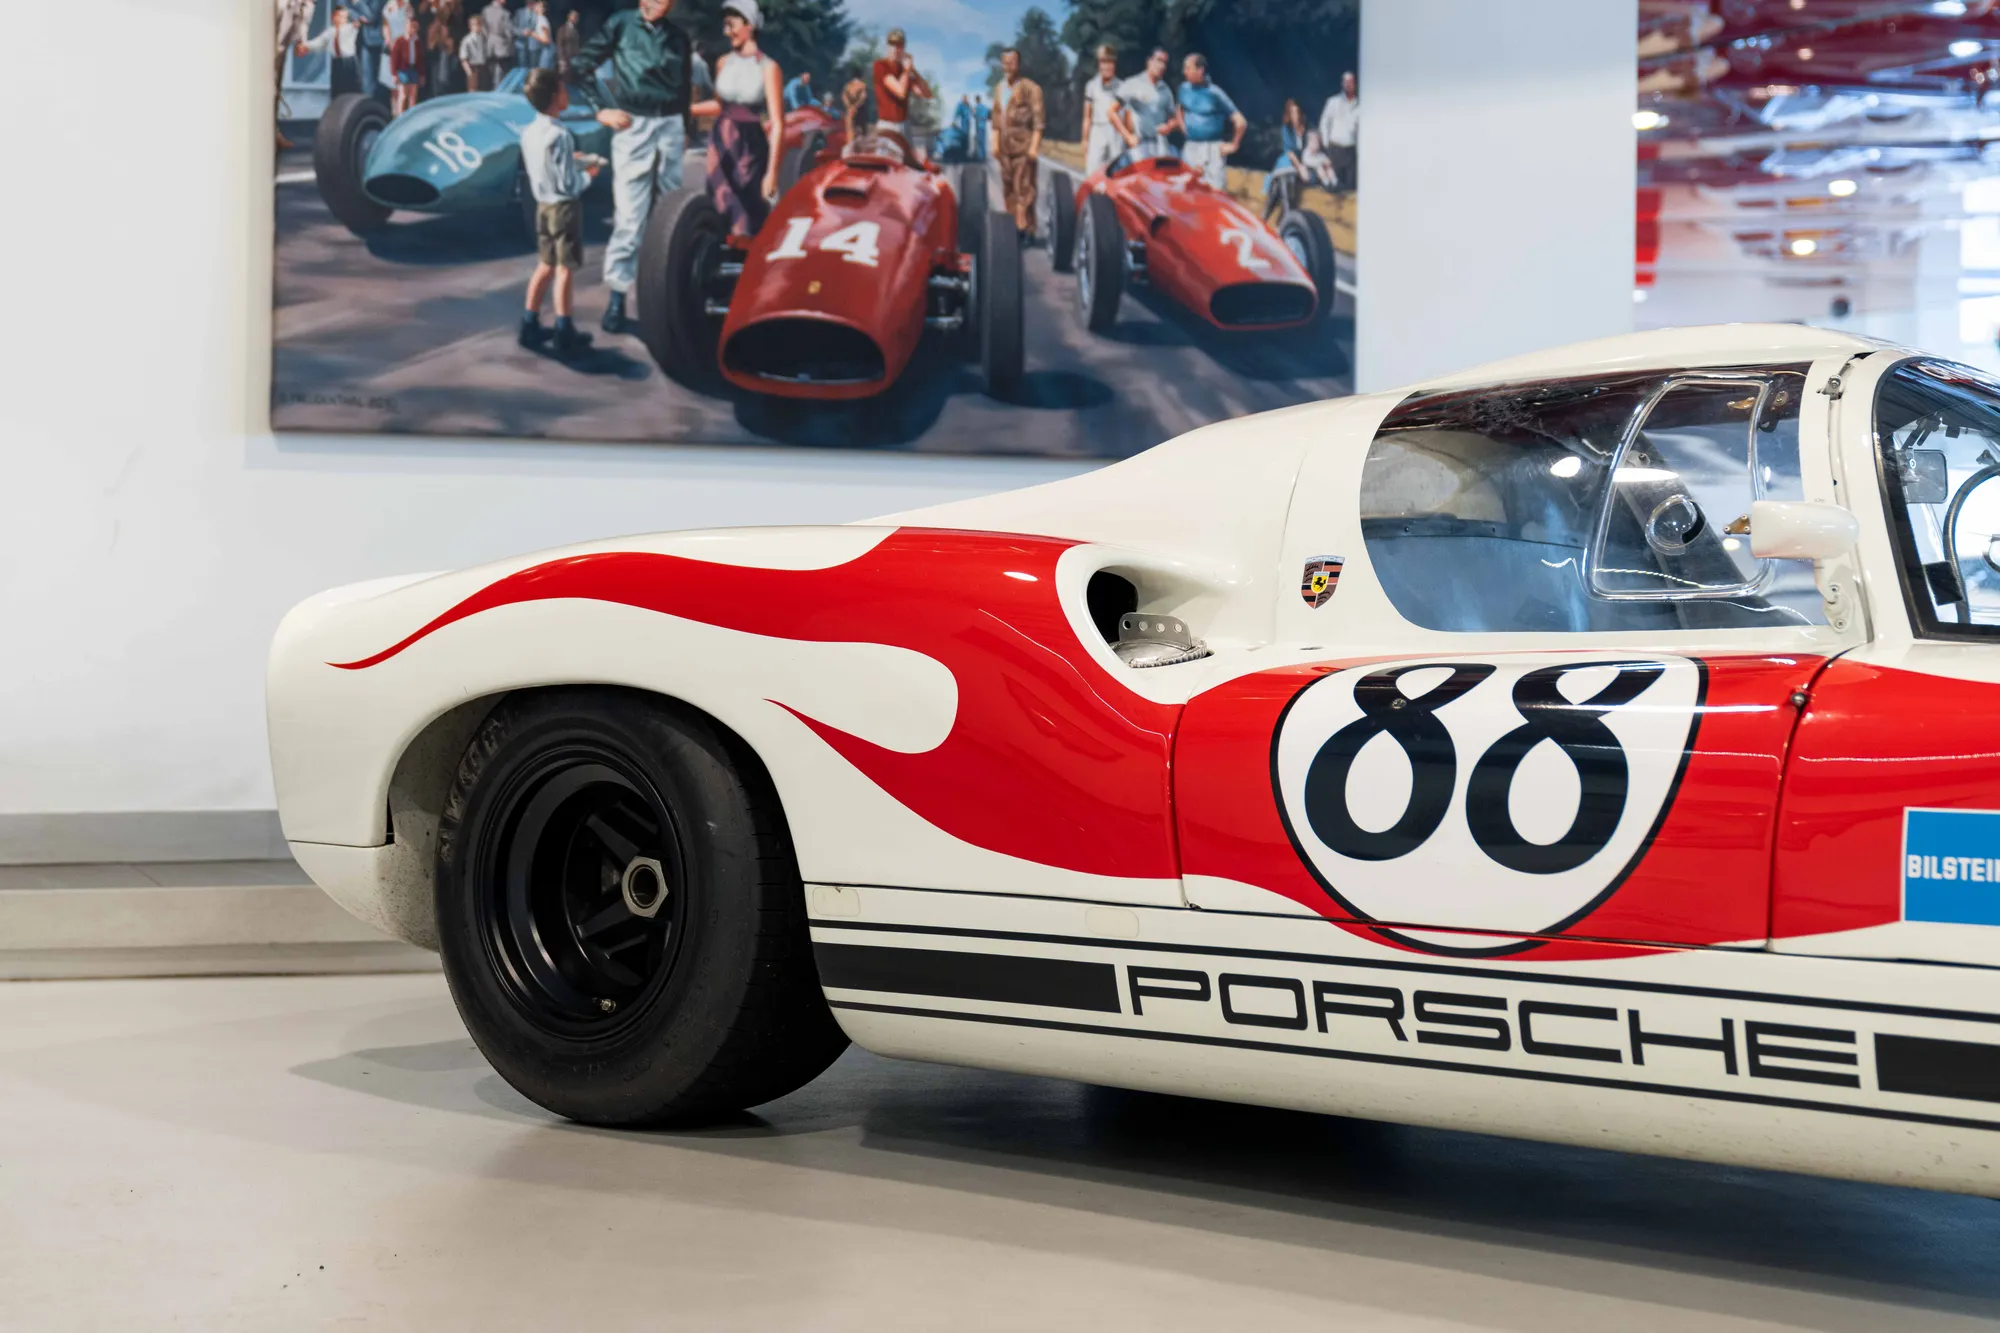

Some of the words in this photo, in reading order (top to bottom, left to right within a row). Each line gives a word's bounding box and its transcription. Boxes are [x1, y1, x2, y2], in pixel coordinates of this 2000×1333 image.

[422, 131, 484, 174] 18
[765, 216, 881, 268] 14
[1303, 660, 1666, 875] 88
[1127, 965, 1862, 1089] PORSCHE
